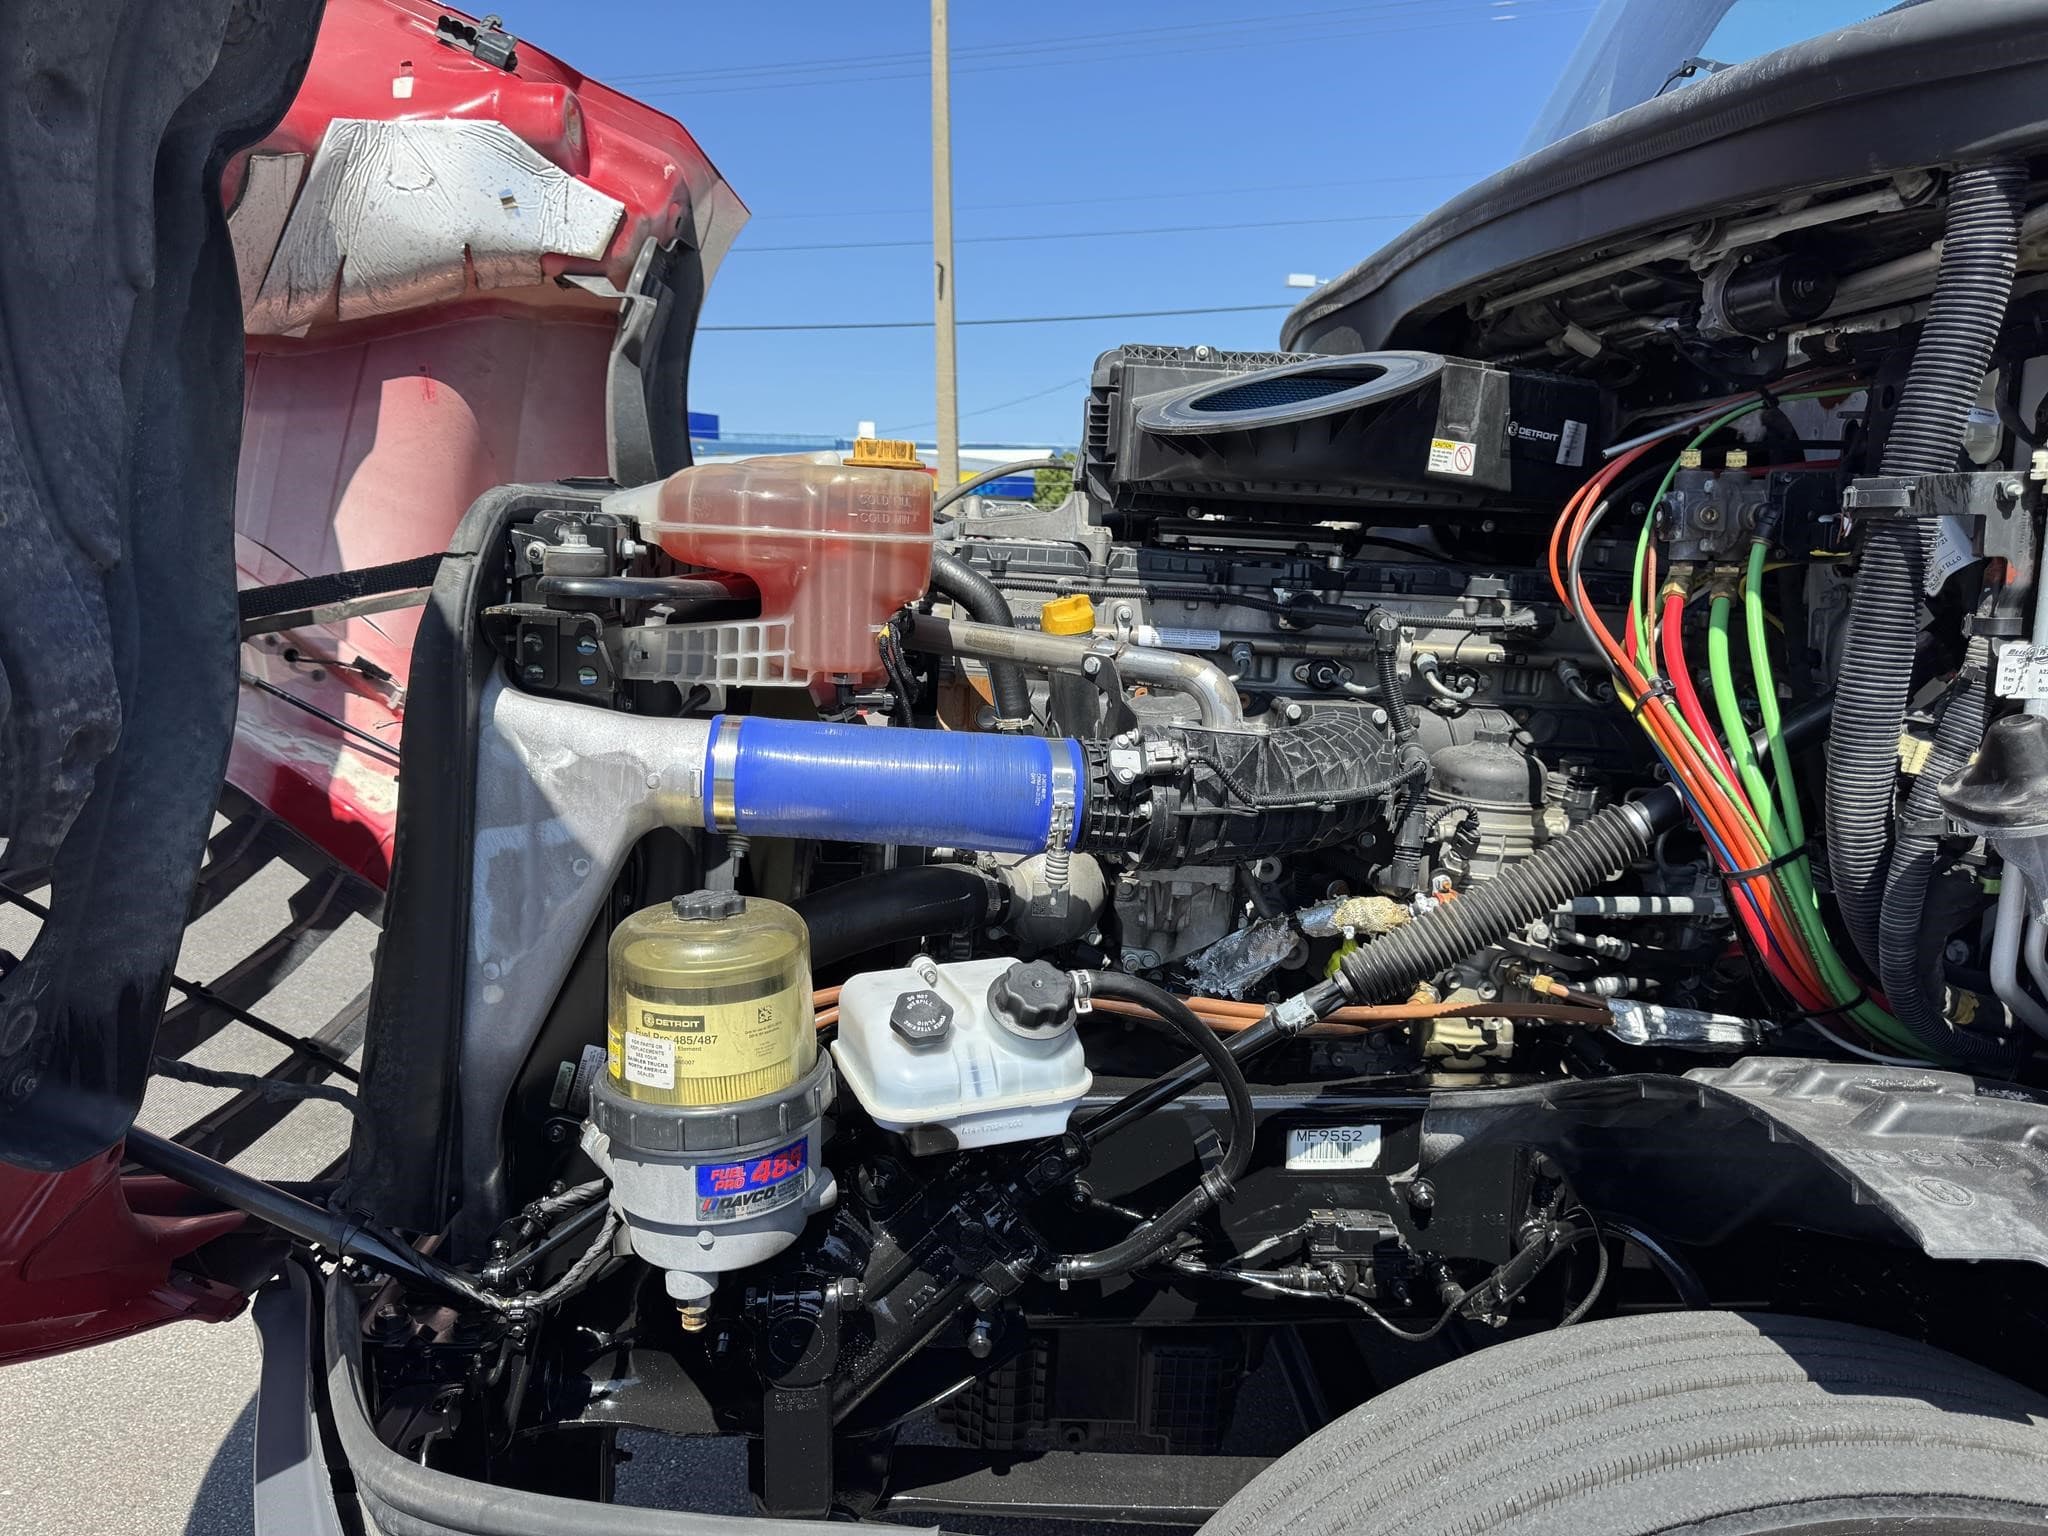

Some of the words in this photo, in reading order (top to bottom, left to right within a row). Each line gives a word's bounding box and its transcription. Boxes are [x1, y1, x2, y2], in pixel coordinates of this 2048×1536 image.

[1518, 427, 1559, 442] DETROIT
[860, 512, 890, 524] COLD
[655, 1018, 700, 1028] DETROIT
[673, 1034, 718, 1045] 485/487
[1296, 1130, 1362, 1142] MF9552
[711, 1165, 746, 1180] FUEL
[714, 1176, 746, 1192] PRO
[720, 1185, 776, 1209] DAVCO
